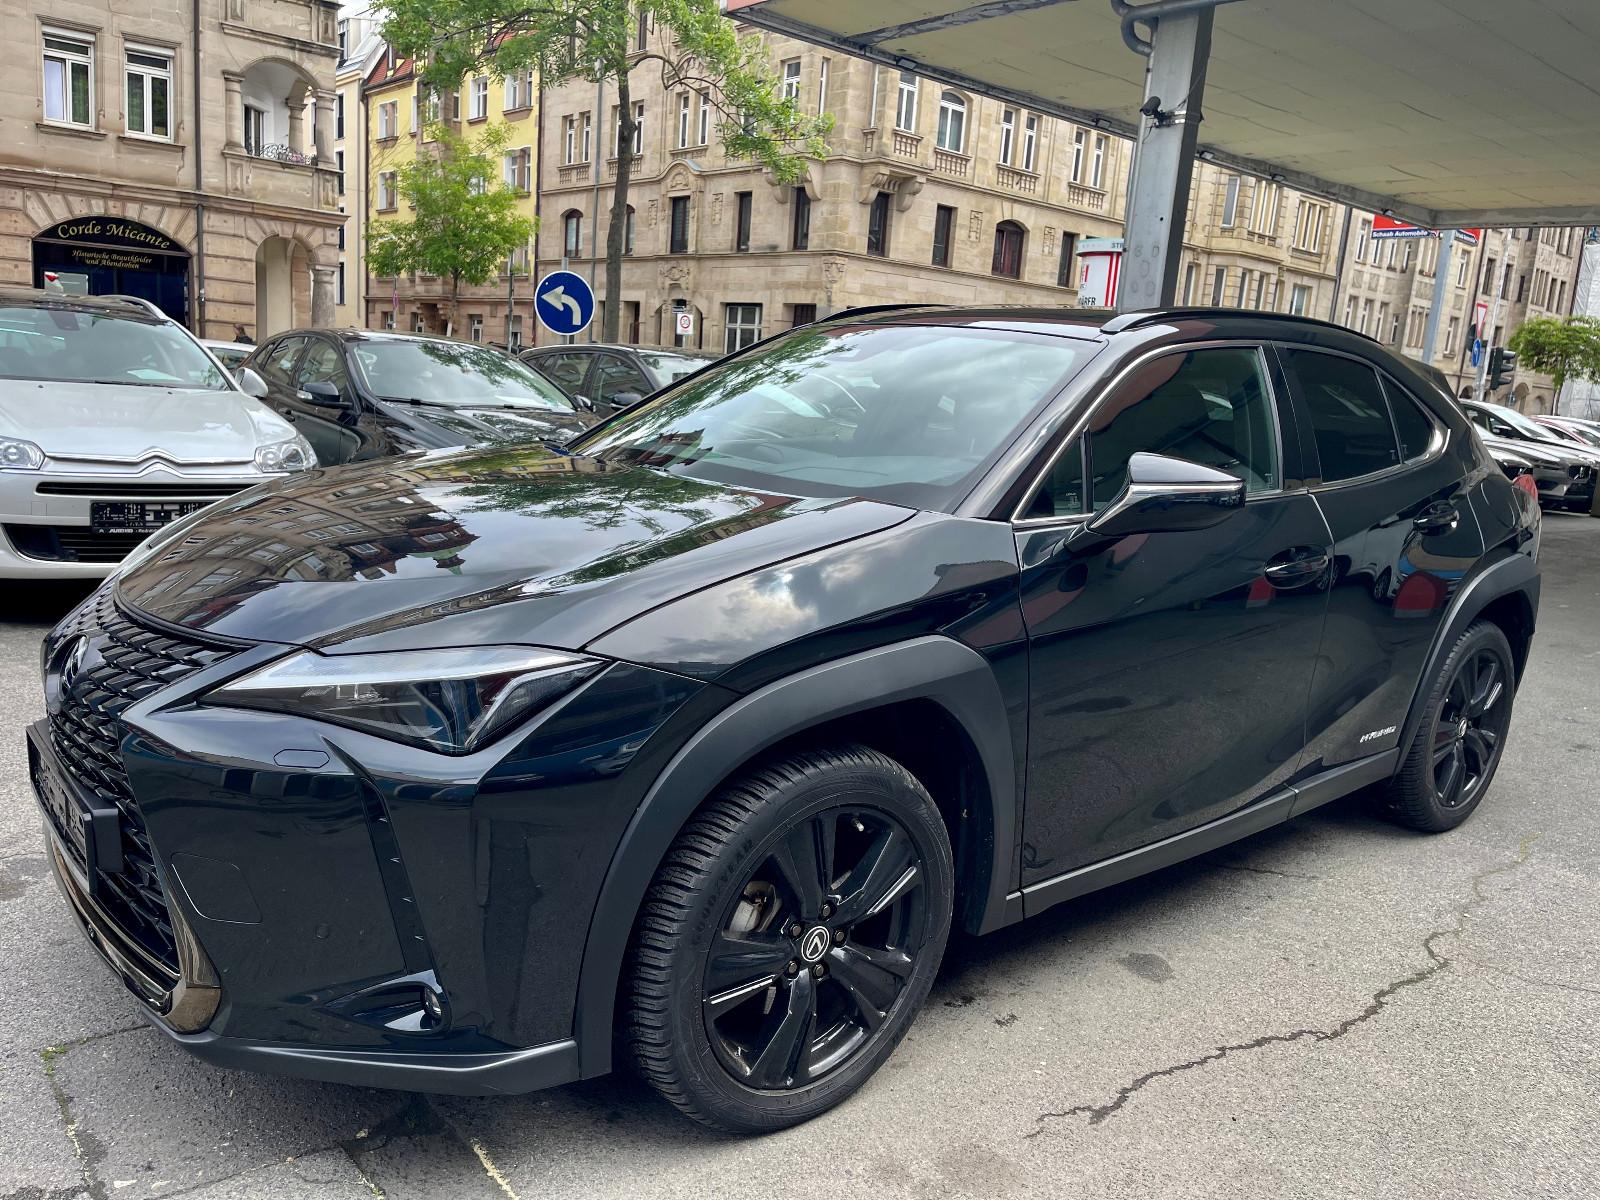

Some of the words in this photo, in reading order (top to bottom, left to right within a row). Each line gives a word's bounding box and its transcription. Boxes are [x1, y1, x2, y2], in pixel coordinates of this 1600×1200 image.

[58, 221, 102, 238] Corde
[105, 224, 170, 249] Micante
[1372, 230, 1393, 238] Schaab
